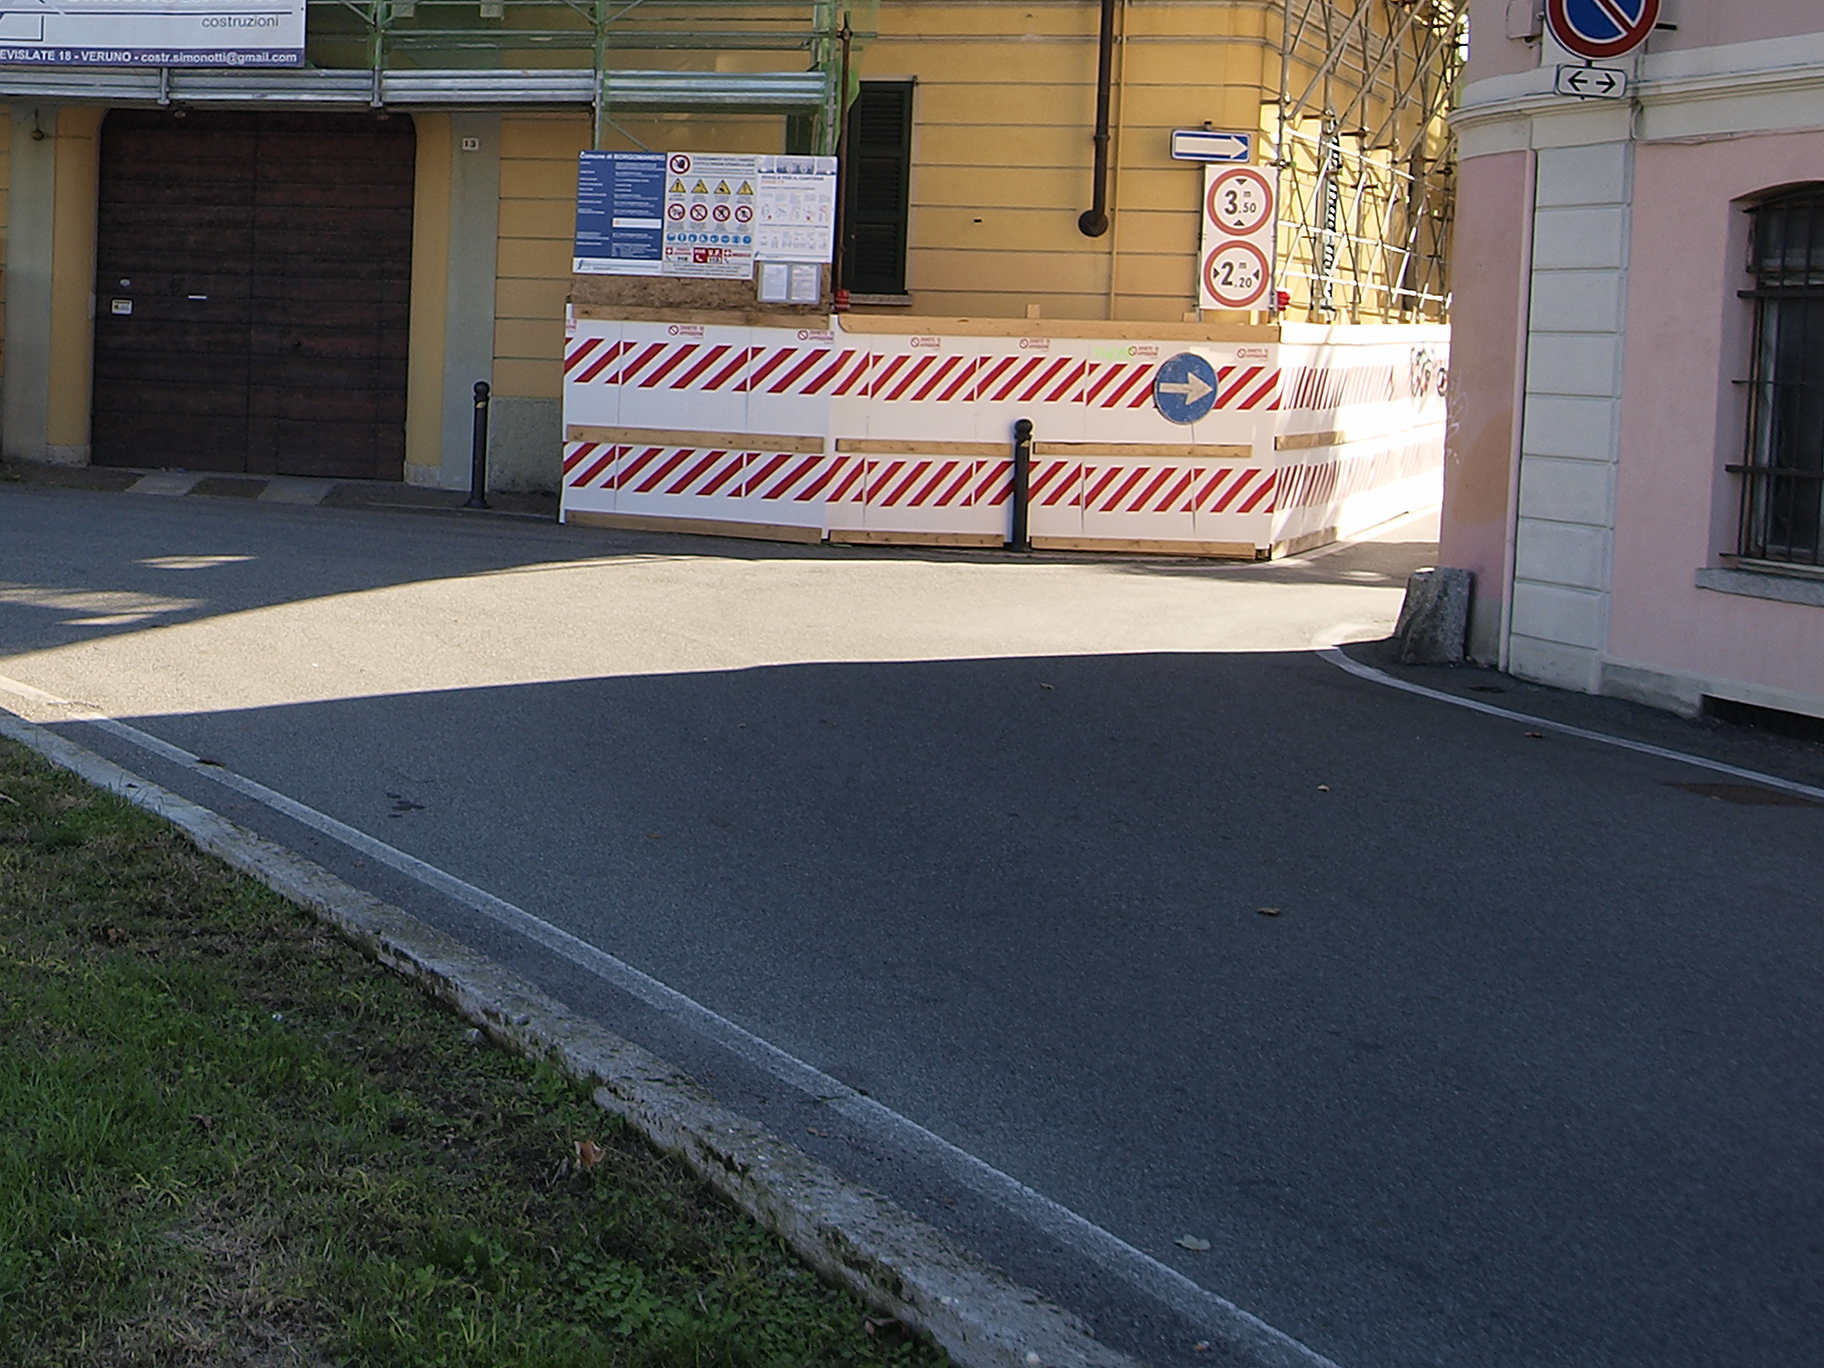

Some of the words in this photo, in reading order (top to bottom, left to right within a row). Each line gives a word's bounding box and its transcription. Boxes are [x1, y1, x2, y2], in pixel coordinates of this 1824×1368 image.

[201, 15, 279, 29] costruzioni
[59, 50, 72, 61] 18
[81, 51, 131, 63] VERUNO
[140, 51, 297, 65] costr.simonotti@gmail.com
